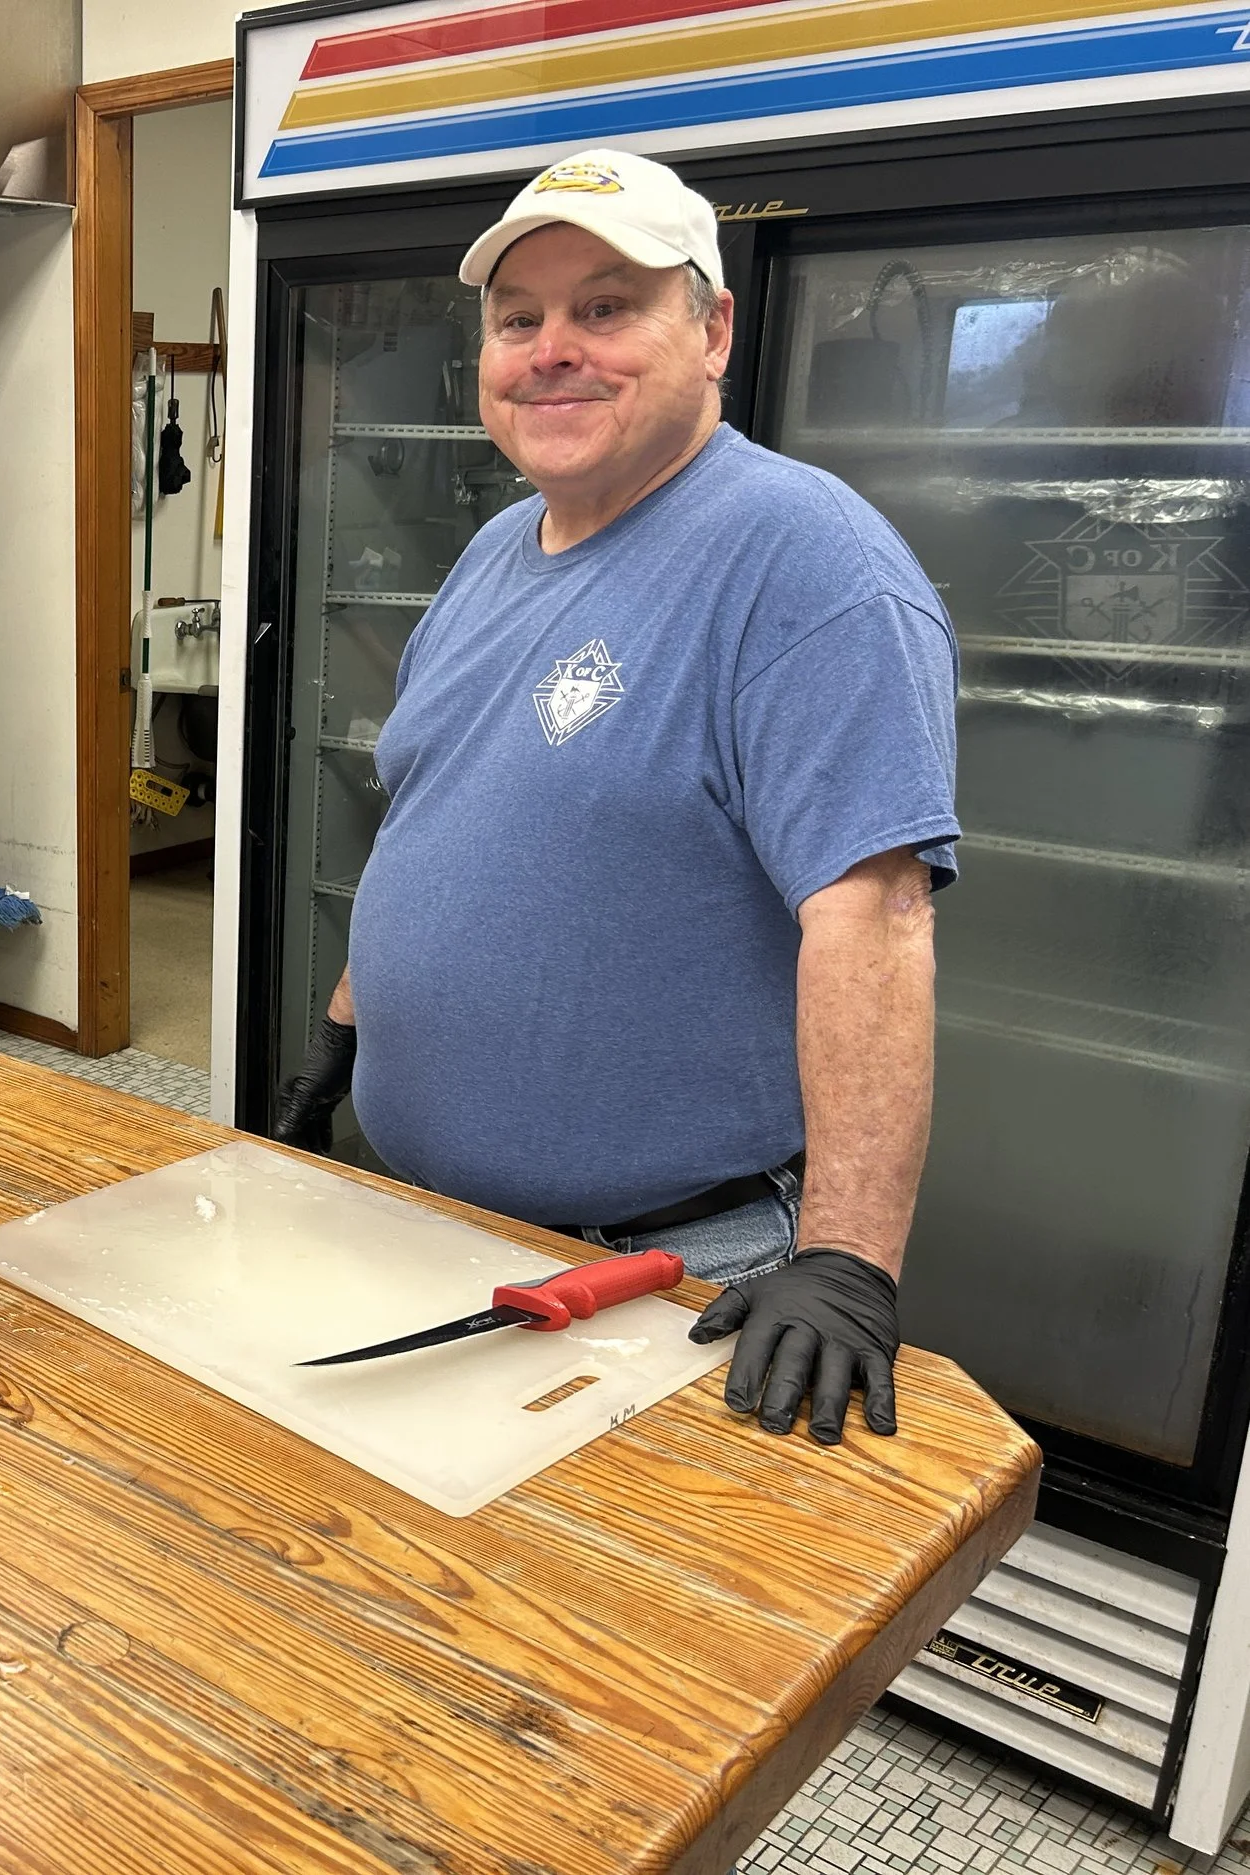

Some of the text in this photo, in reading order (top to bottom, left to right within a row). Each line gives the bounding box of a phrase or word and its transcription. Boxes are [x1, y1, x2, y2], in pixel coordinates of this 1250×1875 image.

[713, 200, 809, 221] rue
[562, 663, 578, 679] K
[591, 665, 607, 681] C
